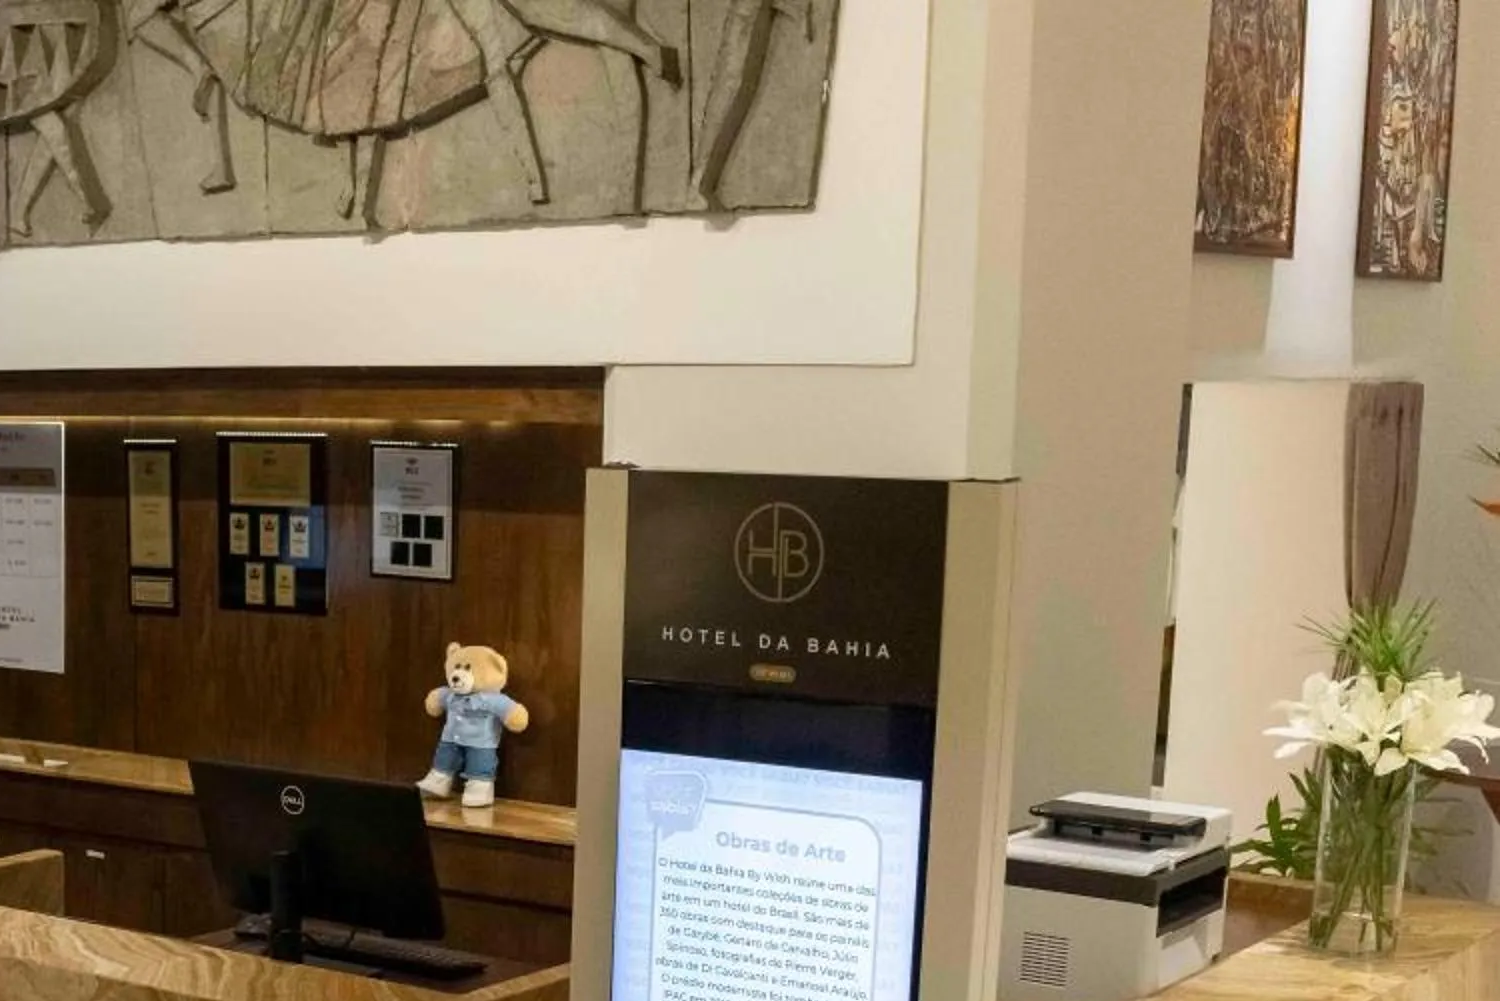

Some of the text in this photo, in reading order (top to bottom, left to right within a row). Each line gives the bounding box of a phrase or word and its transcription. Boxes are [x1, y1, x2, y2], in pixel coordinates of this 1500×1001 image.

[661, 626, 891, 659] HOTEL DA BAHIA
[716, 831, 846, 862] Obras de Arte
